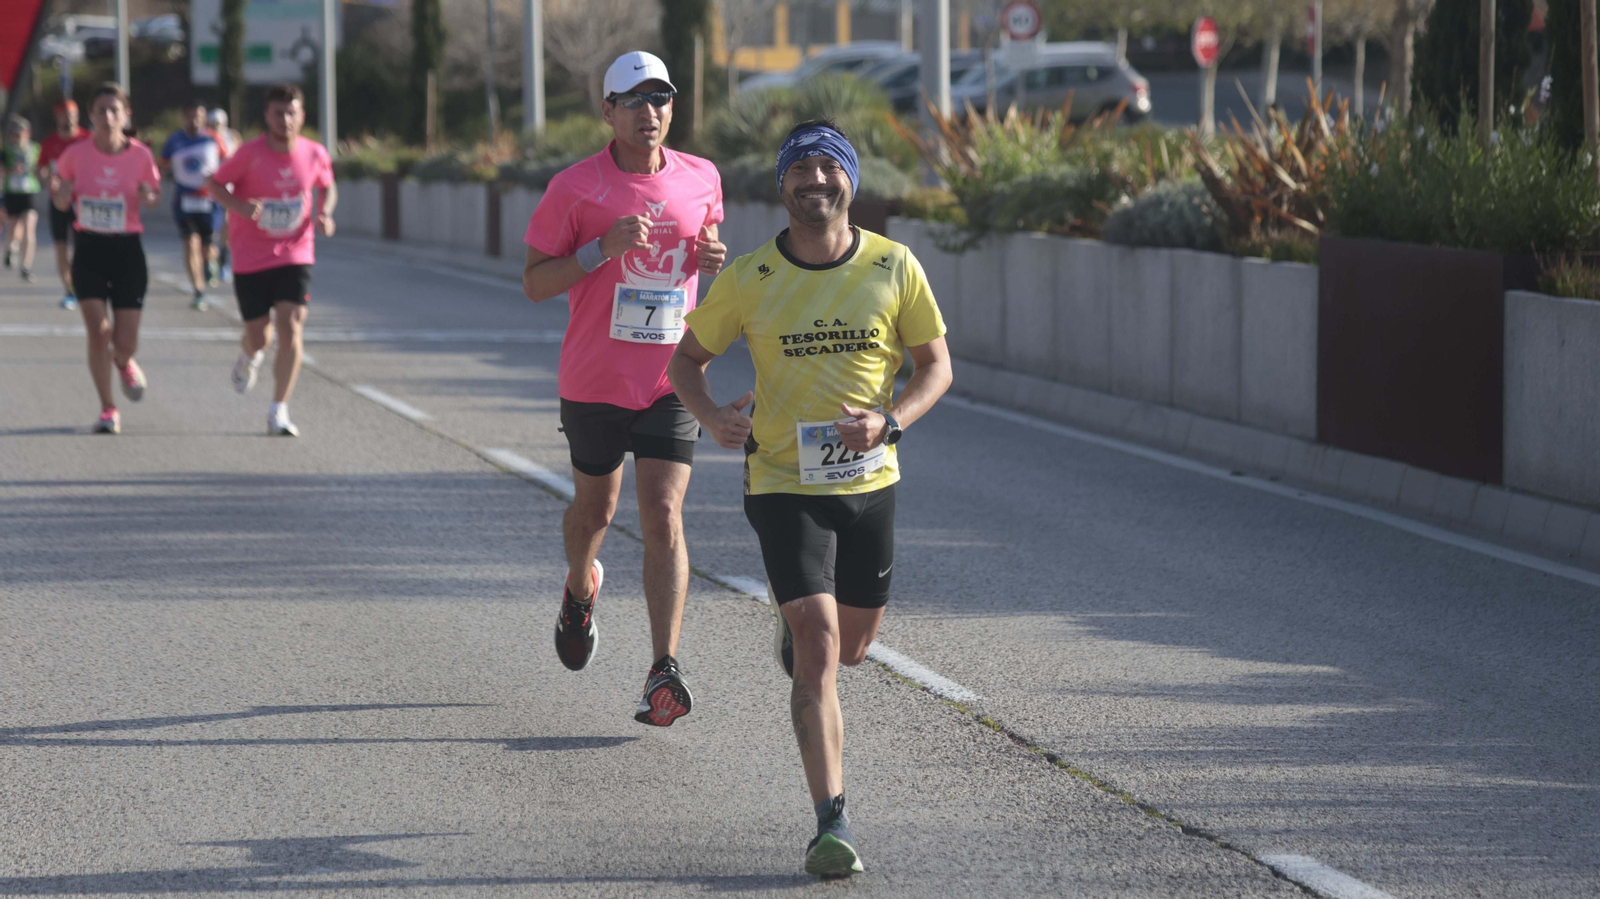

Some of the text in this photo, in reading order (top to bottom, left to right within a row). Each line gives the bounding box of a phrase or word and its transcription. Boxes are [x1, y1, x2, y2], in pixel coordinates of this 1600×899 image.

[639, 292, 669, 302] MARATÓN
[645, 305, 657, 326] 7
[813, 318, 848, 328] C. A.
[630, 331, 666, 341] EVOS
[778, 328, 880, 345] TESORILLO
[783, 341, 880, 357] SECADERO
[825, 466, 866, 480] EVOS
